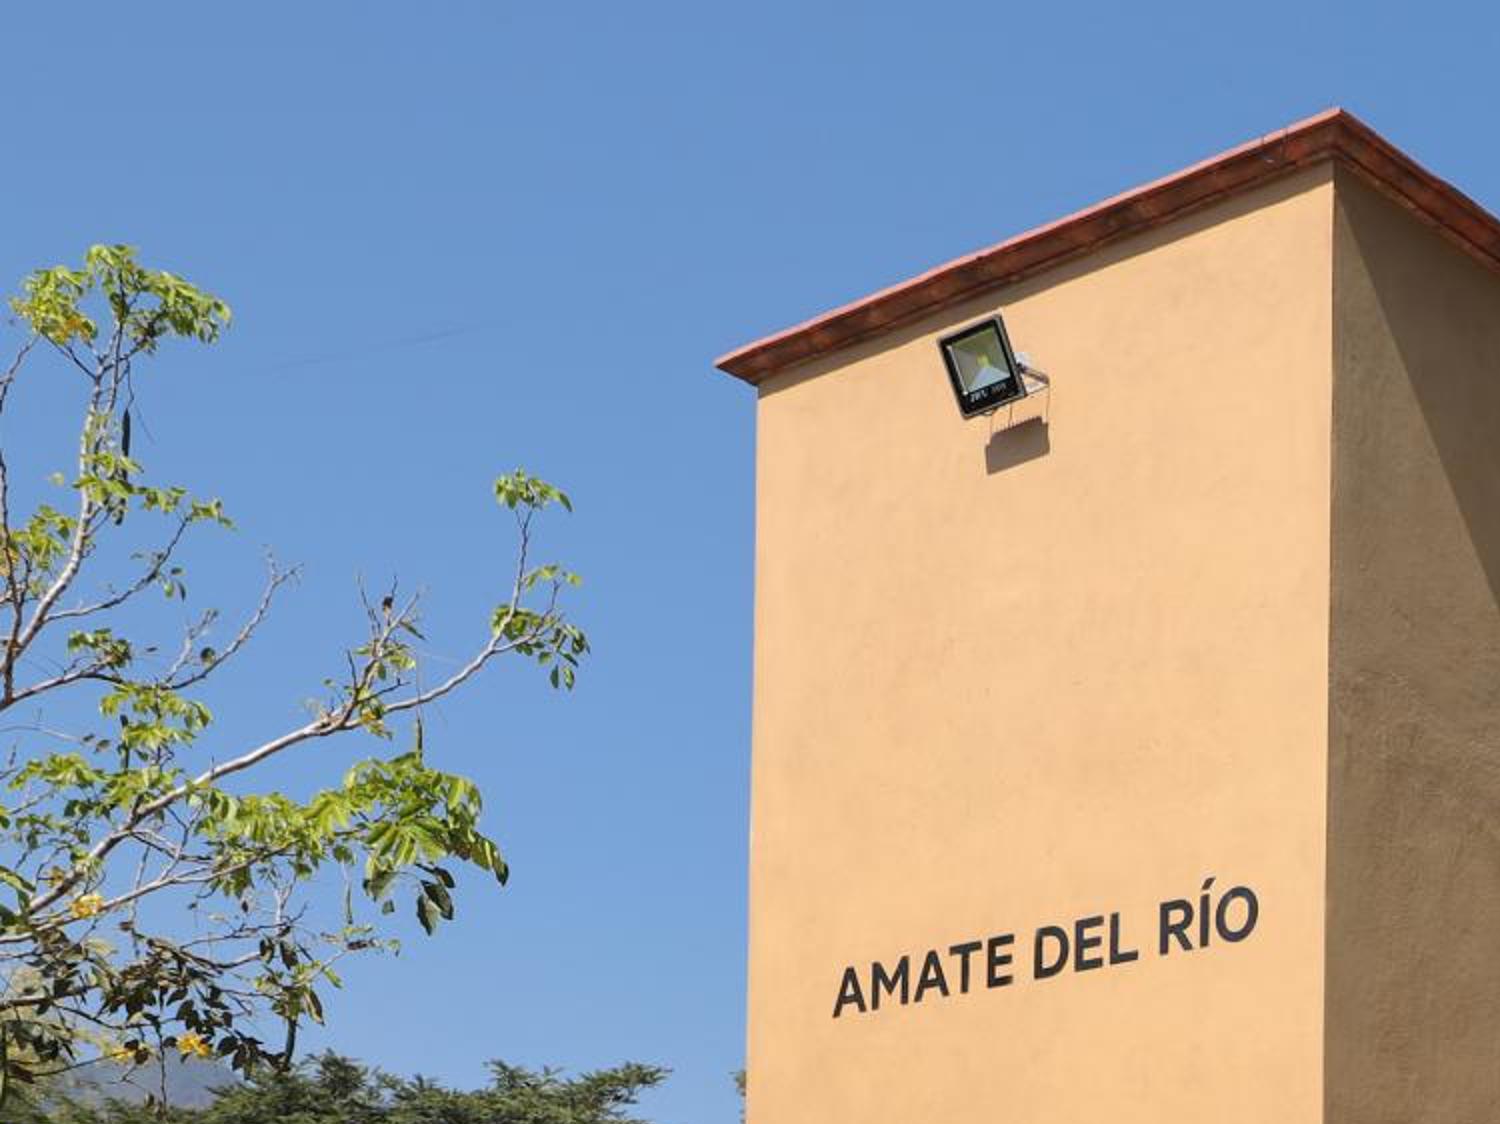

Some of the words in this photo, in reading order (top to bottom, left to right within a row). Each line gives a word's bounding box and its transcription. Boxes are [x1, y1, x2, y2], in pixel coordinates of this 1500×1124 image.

[832, 933, 1016, 1019] AMATE
[1033, 912, 1140, 980] DEL
[1159, 877, 1260, 956] RÍO
